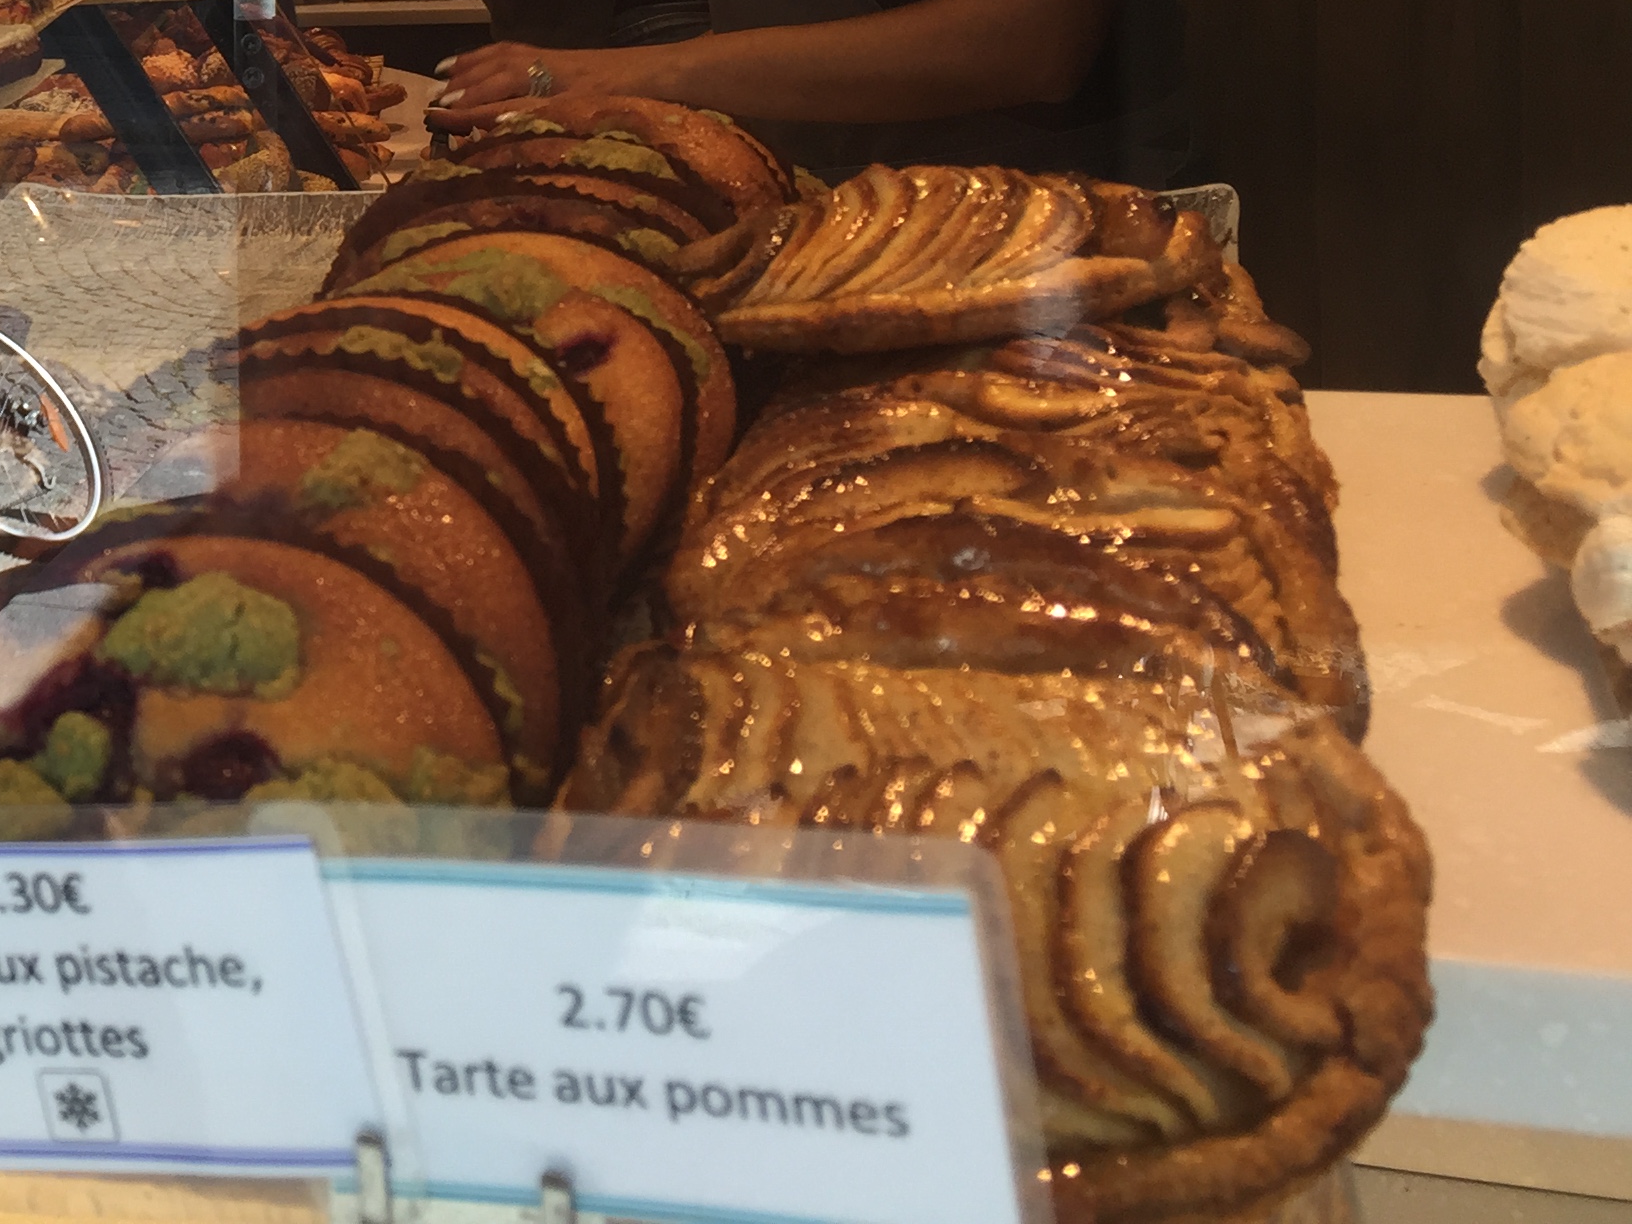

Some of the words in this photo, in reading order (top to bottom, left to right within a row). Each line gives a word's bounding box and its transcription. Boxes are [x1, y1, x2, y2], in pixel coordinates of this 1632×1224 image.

[54, 945, 266, 996] pistache,
[558, 984, 712, 1040] 2.70€
[396, 1048, 538, 1103] Tarte
[553, 1069, 648, 1110] aux
[665, 1077, 911, 1139] pommes
